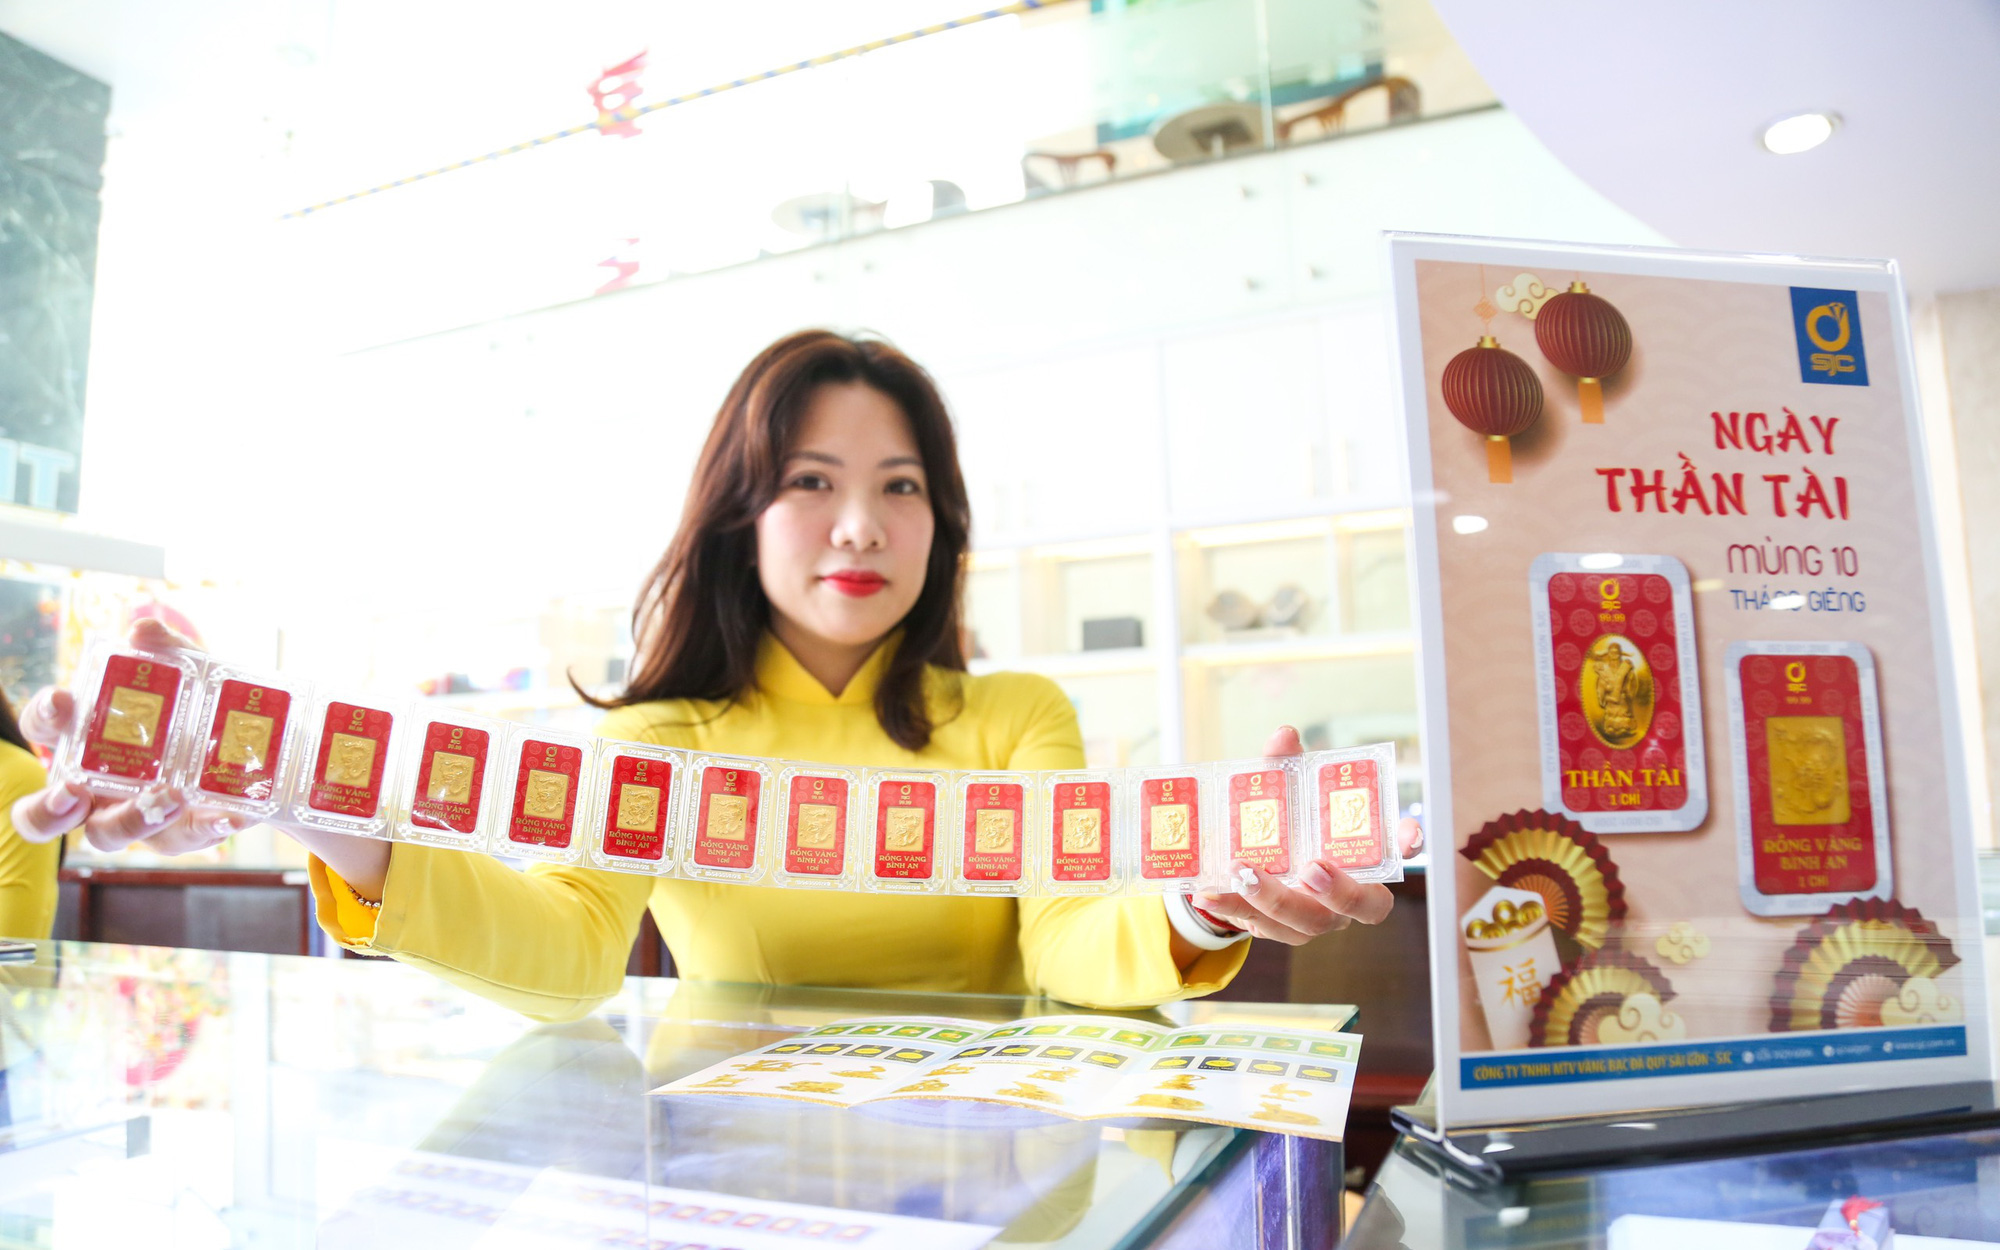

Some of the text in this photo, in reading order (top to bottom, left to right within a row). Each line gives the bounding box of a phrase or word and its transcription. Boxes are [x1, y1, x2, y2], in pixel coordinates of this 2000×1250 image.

[1710, 406, 1840, 456] NGÀY
[1594, 451, 1850, 521] THẦN TÀI
[1831, 546, 1859, 577] 10
[1808, 587, 1867, 613] GIÊNG
[1565, 761, 1681, 787] THẦN TÀI
[1610, 794, 1617, 806] 1
[1824, 855, 1848, 869] AN
[1497, 957, 1542, 1008] 福
